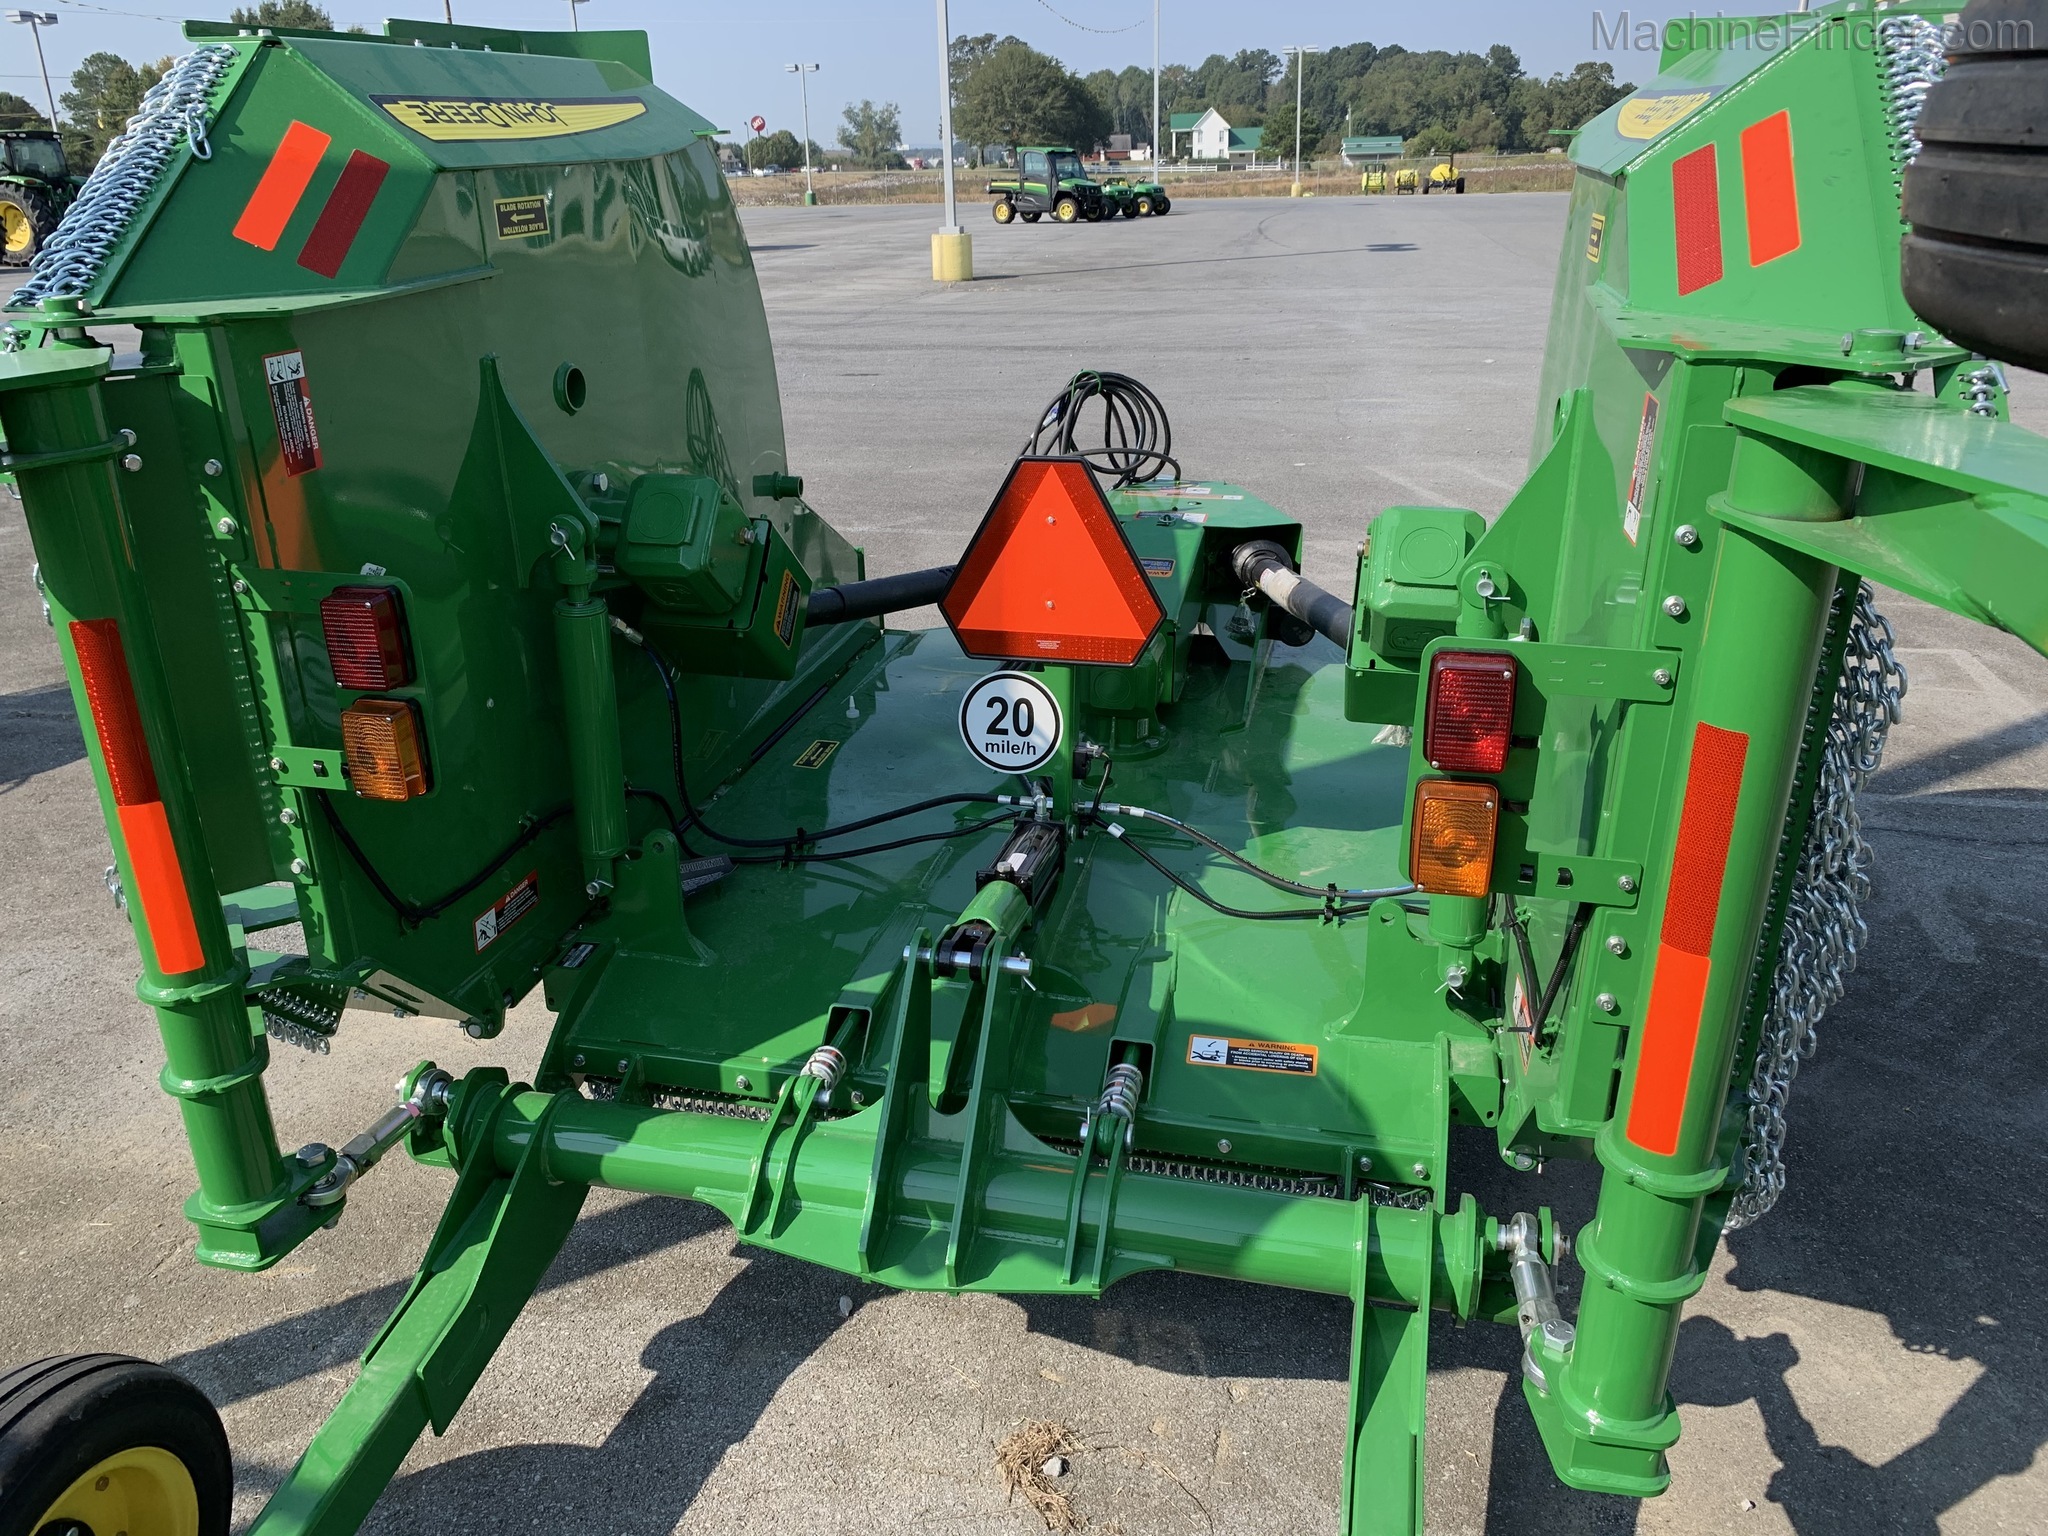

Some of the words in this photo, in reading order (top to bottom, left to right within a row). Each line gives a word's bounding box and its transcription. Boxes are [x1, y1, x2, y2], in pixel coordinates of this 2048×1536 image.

[404, 104, 513, 128] DEERE
[496, 104, 569, 127] JOHN
[500, 203, 517, 212] BLADE
[517, 201, 541, 210] ROTATION
[305, 407, 319, 450] DANGER
[778, 573, 790, 617] WARNING
[986, 695, 1035, 738] 20
[985, 740, 1036, 756] mile/h
[1257, 1042, 1296, 1050] WARNING
